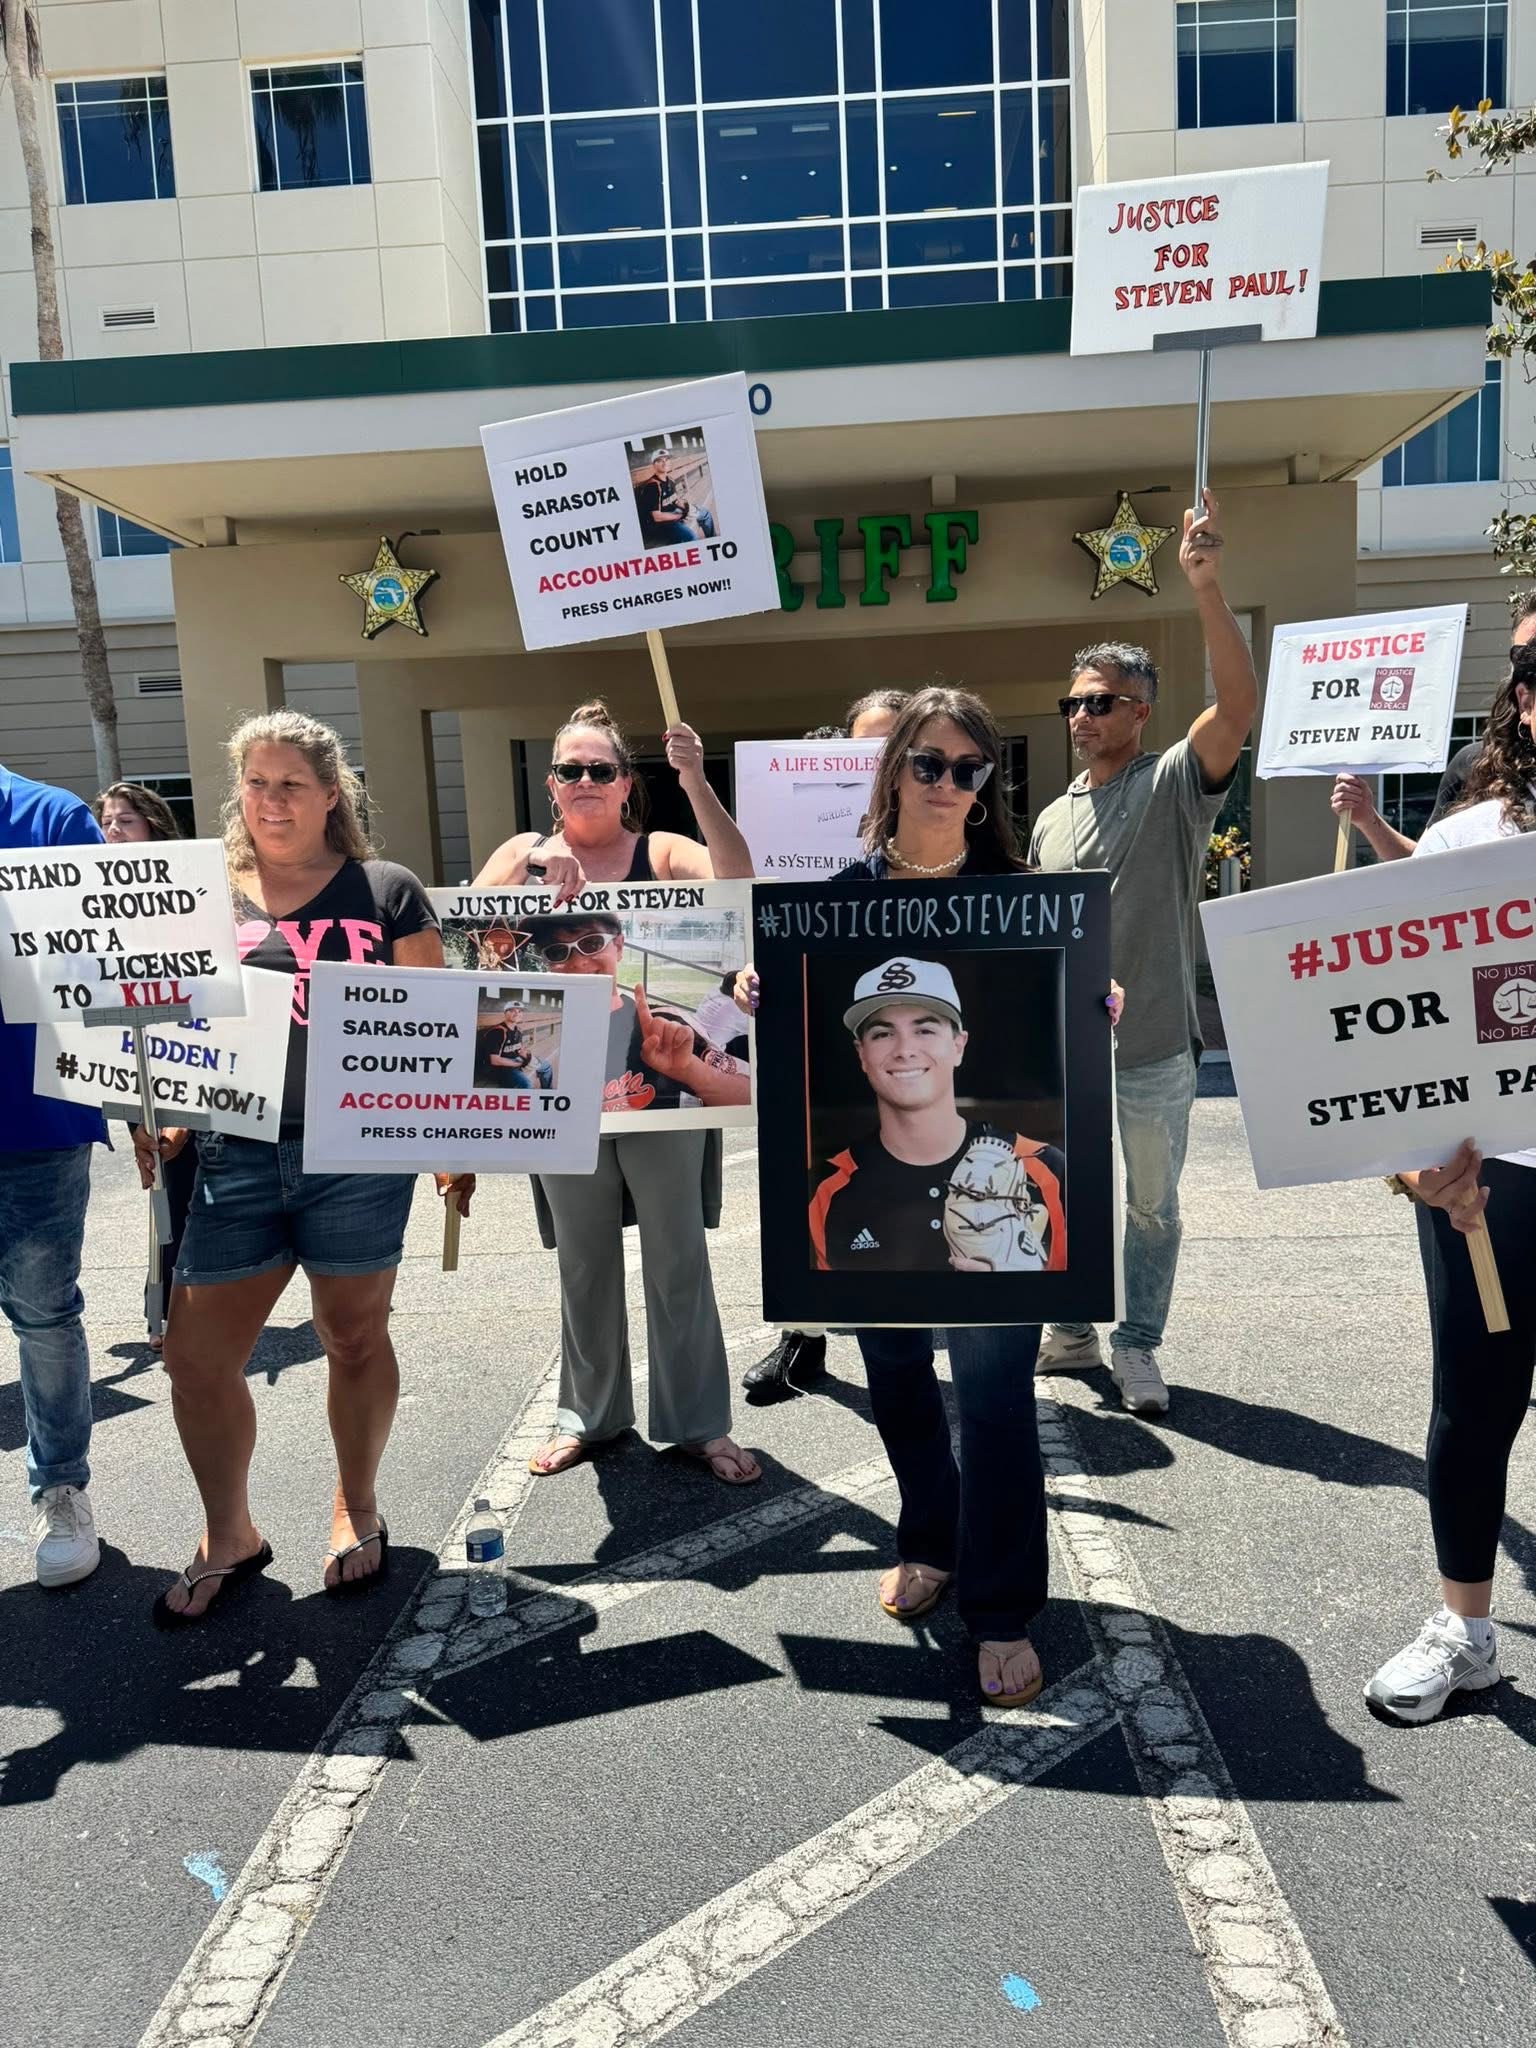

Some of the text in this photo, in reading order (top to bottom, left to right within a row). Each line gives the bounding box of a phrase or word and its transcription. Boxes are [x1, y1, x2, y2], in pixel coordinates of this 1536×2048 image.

[1108, 195, 1219, 234] JUSTICE
[1154, 242, 1209, 271] FOR
[1114, 269, 1308, 310] STEVEN PAUL!
[515, 461, 568, 486] HOLD
[522, 486, 621, 519] SARASOTA
[529, 522, 621, 556] COUNTY
[538, 541, 738, 593] ACCOUNTABLE TO
[562, 578, 732, 619] PRESS CHARGES NOW!!
[1302, 632, 1425, 664] #JUSTICE
[1311, 678, 1360, 700] FOR
[1289, 724, 1421, 745] STEVEN PAUL
[769, 758, 780, 771] A
[785, 758, 818, 771] LIFE
[0, 859, 173, 892] STAND YOUR
[764, 855, 774, 868] A
[778, 854, 833, 869] SYSTEM
[449, 894, 552, 917] JUSTICE
[617, 887, 705, 910] STEVEN
[10, 927, 125, 957] IS NOT A
[1288, 899, 1536, 980] #JUSTIC
[96, 950, 218, 981] LICENSE
[1476, 968, 1499, 980] NO
[53, 981, 192, 1009] TO KILL
[344, 986, 408, 1003] HOLD
[343, 1020, 459, 1039] SARASOTA
[1330, 991, 1449, 1042] FOR
[1480, 1029, 1505, 1040] NO
[121, 1031, 220, 1071] HDDEN
[342, 1055, 453, 1073] COUNTY
[56, 1052, 267, 1121] #JUSTCE NOW!
[1308, 1076, 1470, 1126] STEVEN
[340, 1093, 571, 1111] ACCOUNTABLE TO
[361, 1127, 556, 1139] PRESS CHARGES NOW!!
[850, 1240, 880, 1250] adidas
